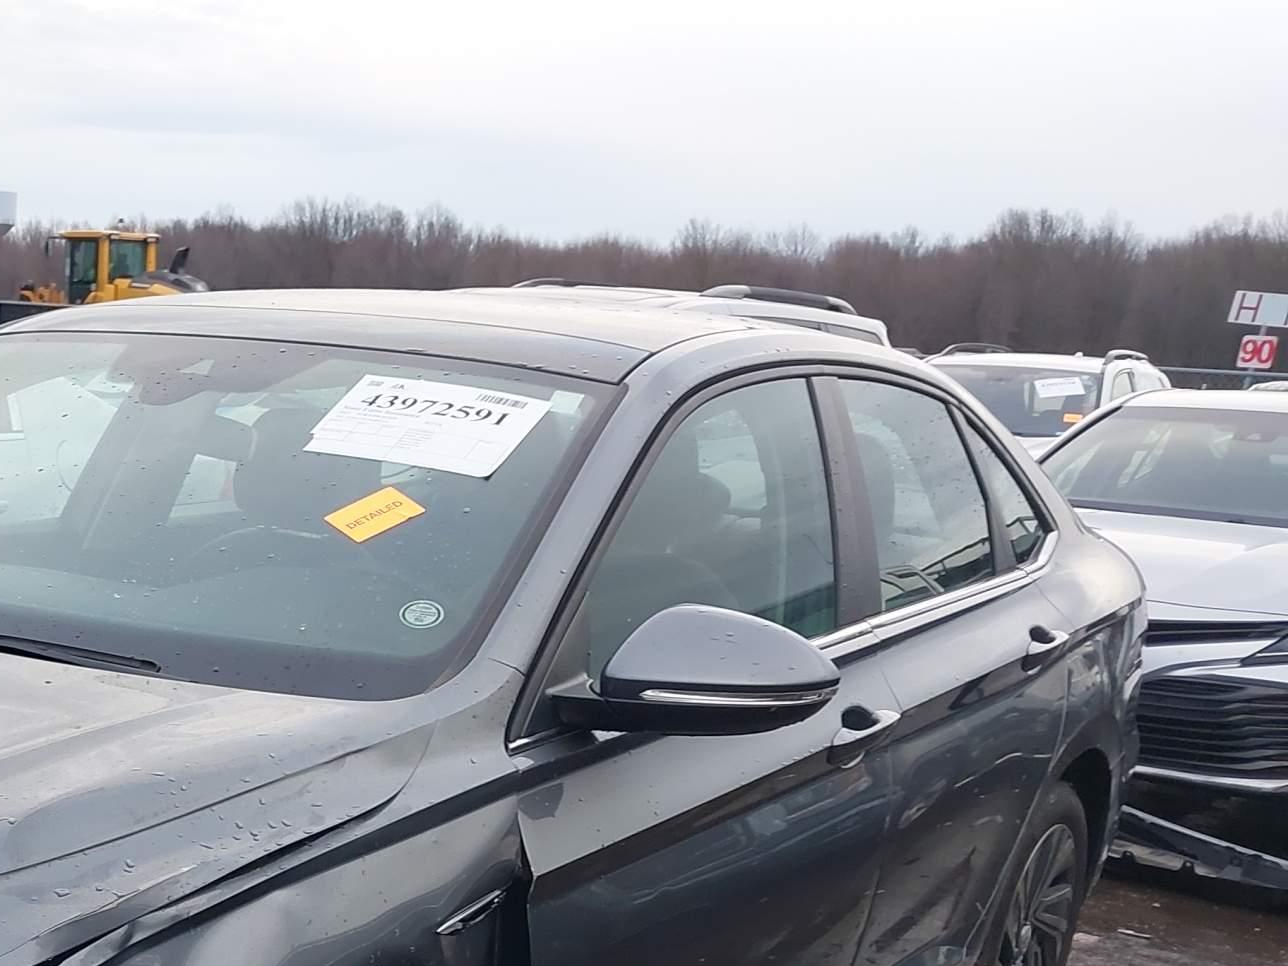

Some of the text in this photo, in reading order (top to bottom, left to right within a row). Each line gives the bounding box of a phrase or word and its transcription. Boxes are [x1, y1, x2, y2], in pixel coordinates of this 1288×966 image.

[1240, 338, 1275, 364] 90
[361, 392, 510, 426] 43972591
[344, 499, 404, 530] DETAILED
